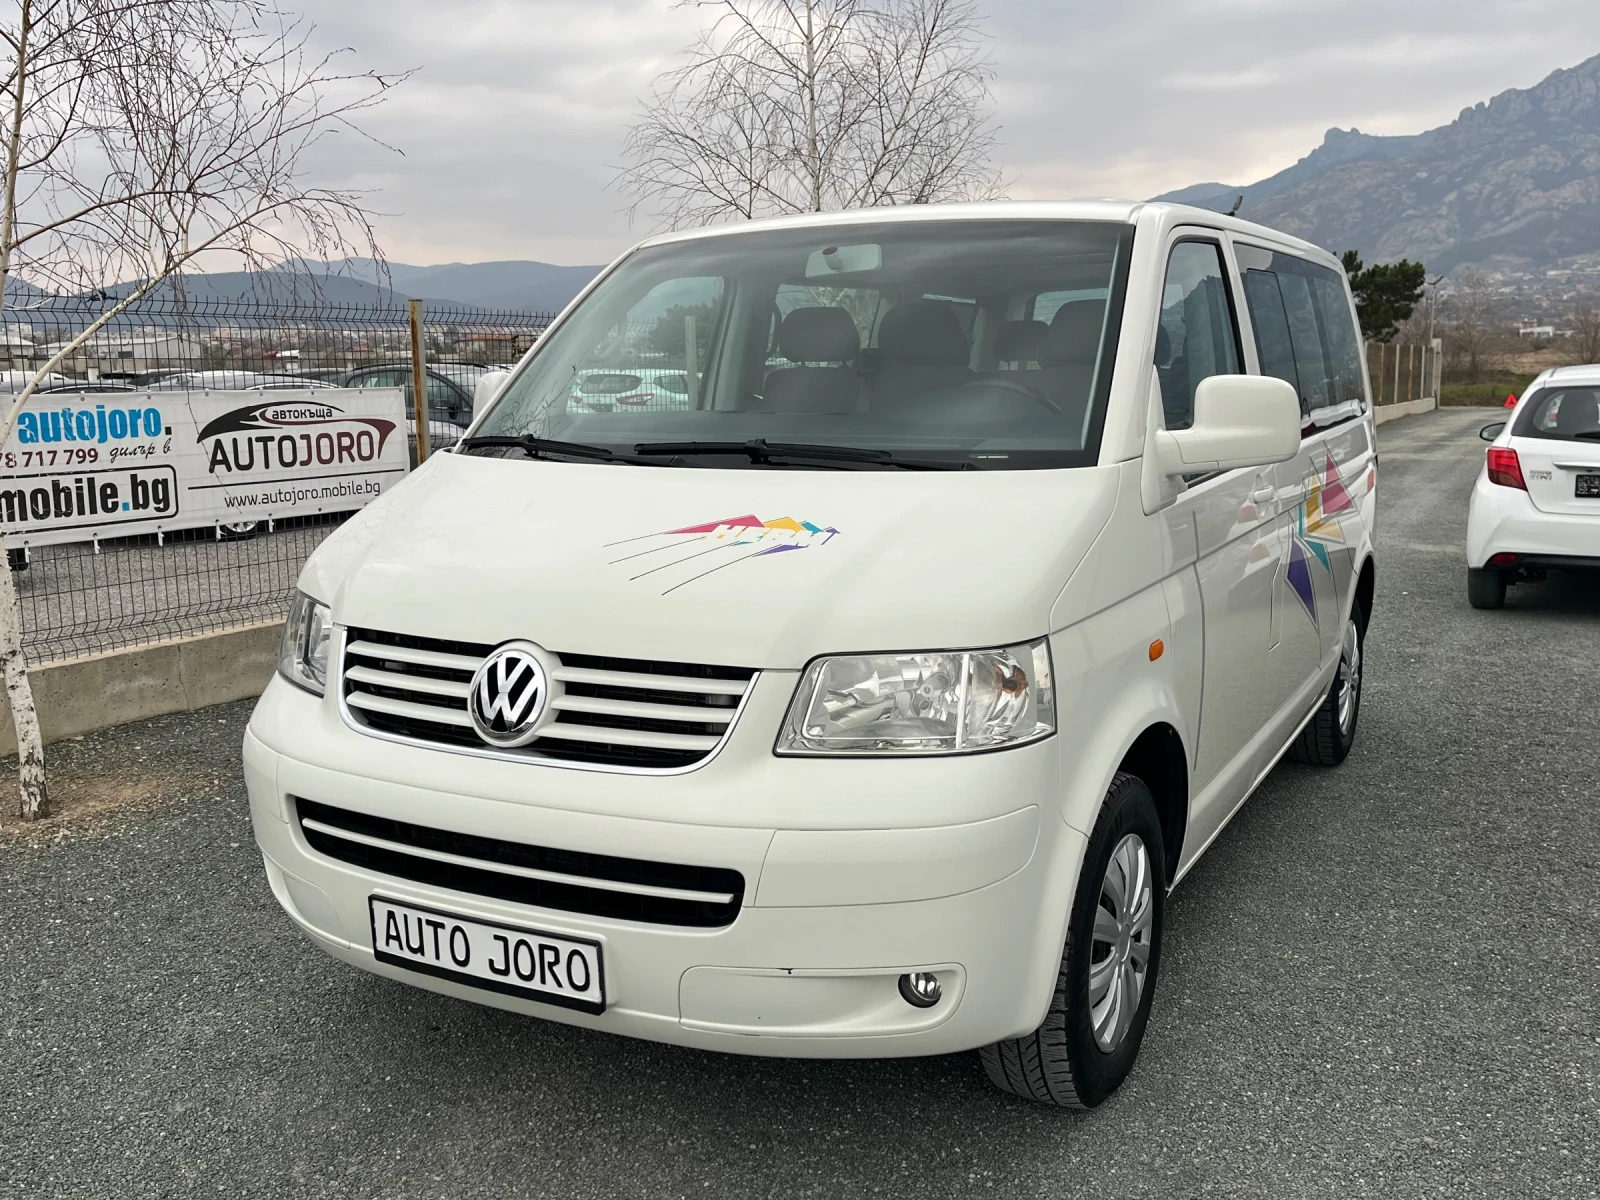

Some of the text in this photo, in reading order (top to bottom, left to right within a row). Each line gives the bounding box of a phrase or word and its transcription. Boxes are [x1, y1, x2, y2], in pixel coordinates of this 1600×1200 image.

[271, 408, 333, 420] автокъща
[0, 447, 99, 468] 8 717 799
[208, 430, 376, 474] AUTOJORO
[0, 473, 171, 523] mobile.bg
[224, 479, 381, 508] www.autojoro.mobile.bg
[385, 909, 591, 992] AUTO JORO
